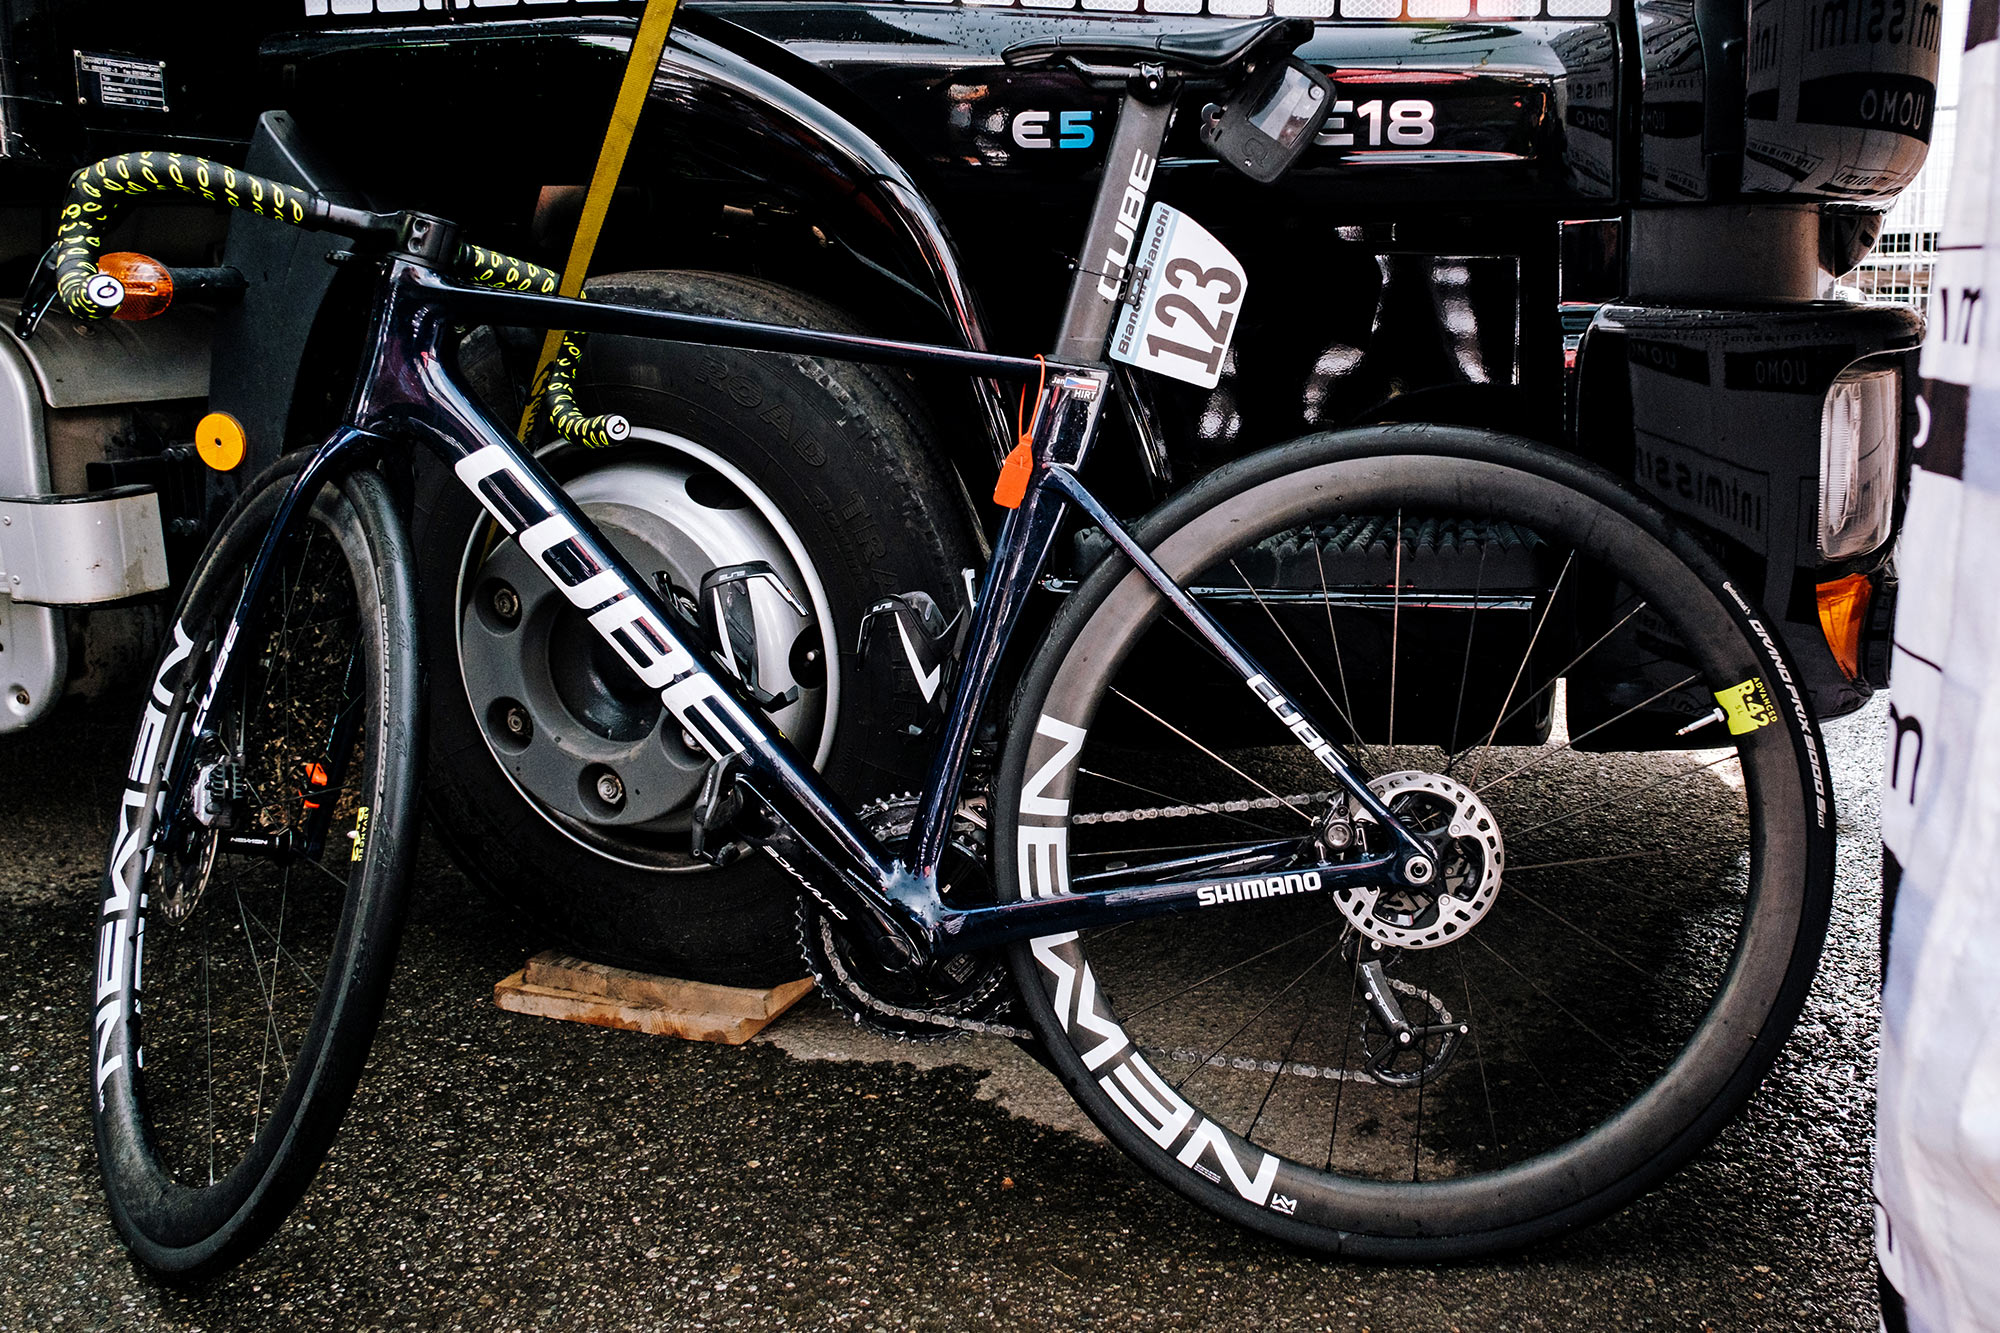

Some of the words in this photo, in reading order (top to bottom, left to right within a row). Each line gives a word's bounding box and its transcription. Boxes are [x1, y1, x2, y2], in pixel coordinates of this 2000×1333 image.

[1012, 111, 1095, 149] E5
[1097, 148, 1156, 301] CUBE
[1146, 257, 1232, 376] 123
[1051, 376, 1065, 385] Jan
[1074, 389, 1096, 400] HIRT
[455, 444, 766, 760] CUBE
[191, 617, 240, 737] CUBE
[1247, 673, 1348, 774] CUBE
[1749, 619, 1793, 685] GRAND
[1785, 684, 1811, 734] PRIX
[1804, 734, 1825, 796] 5000
[1752, 677, 1778, 723] ADVANCED
[1196, 871, 1322, 907] SHIMANO
